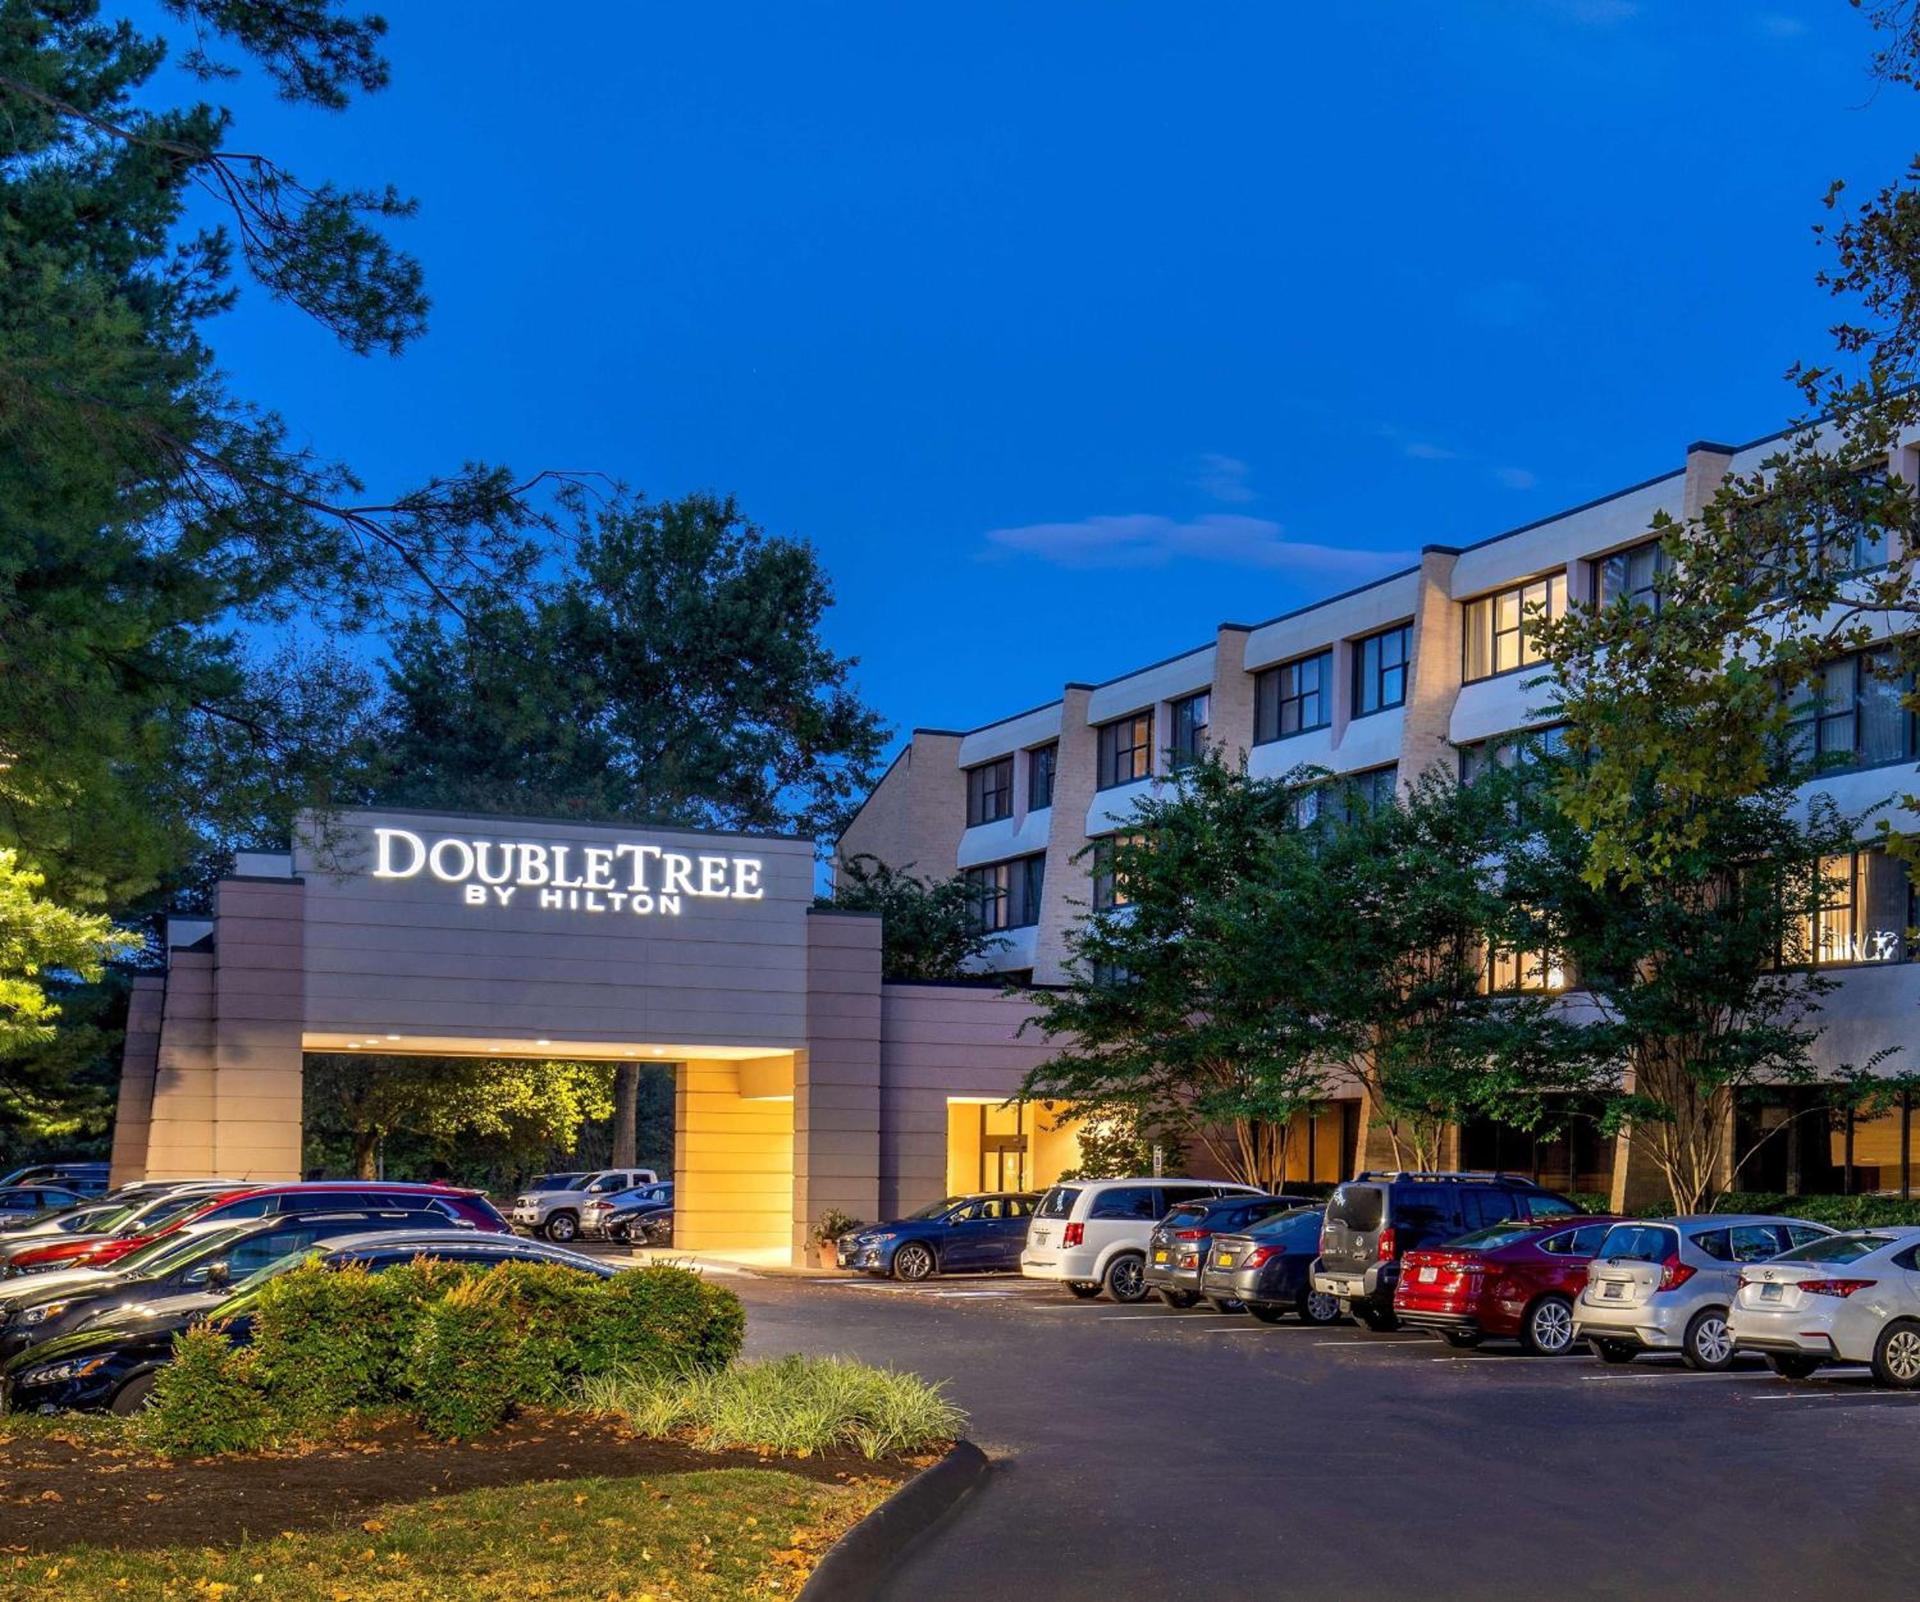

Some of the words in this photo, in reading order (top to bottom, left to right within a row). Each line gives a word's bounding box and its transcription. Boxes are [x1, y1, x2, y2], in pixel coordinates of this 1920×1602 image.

[372, 827, 764, 900] DOUBLETREE
[464, 883, 517, 906] BY
[540, 888, 681, 916] HILTON
